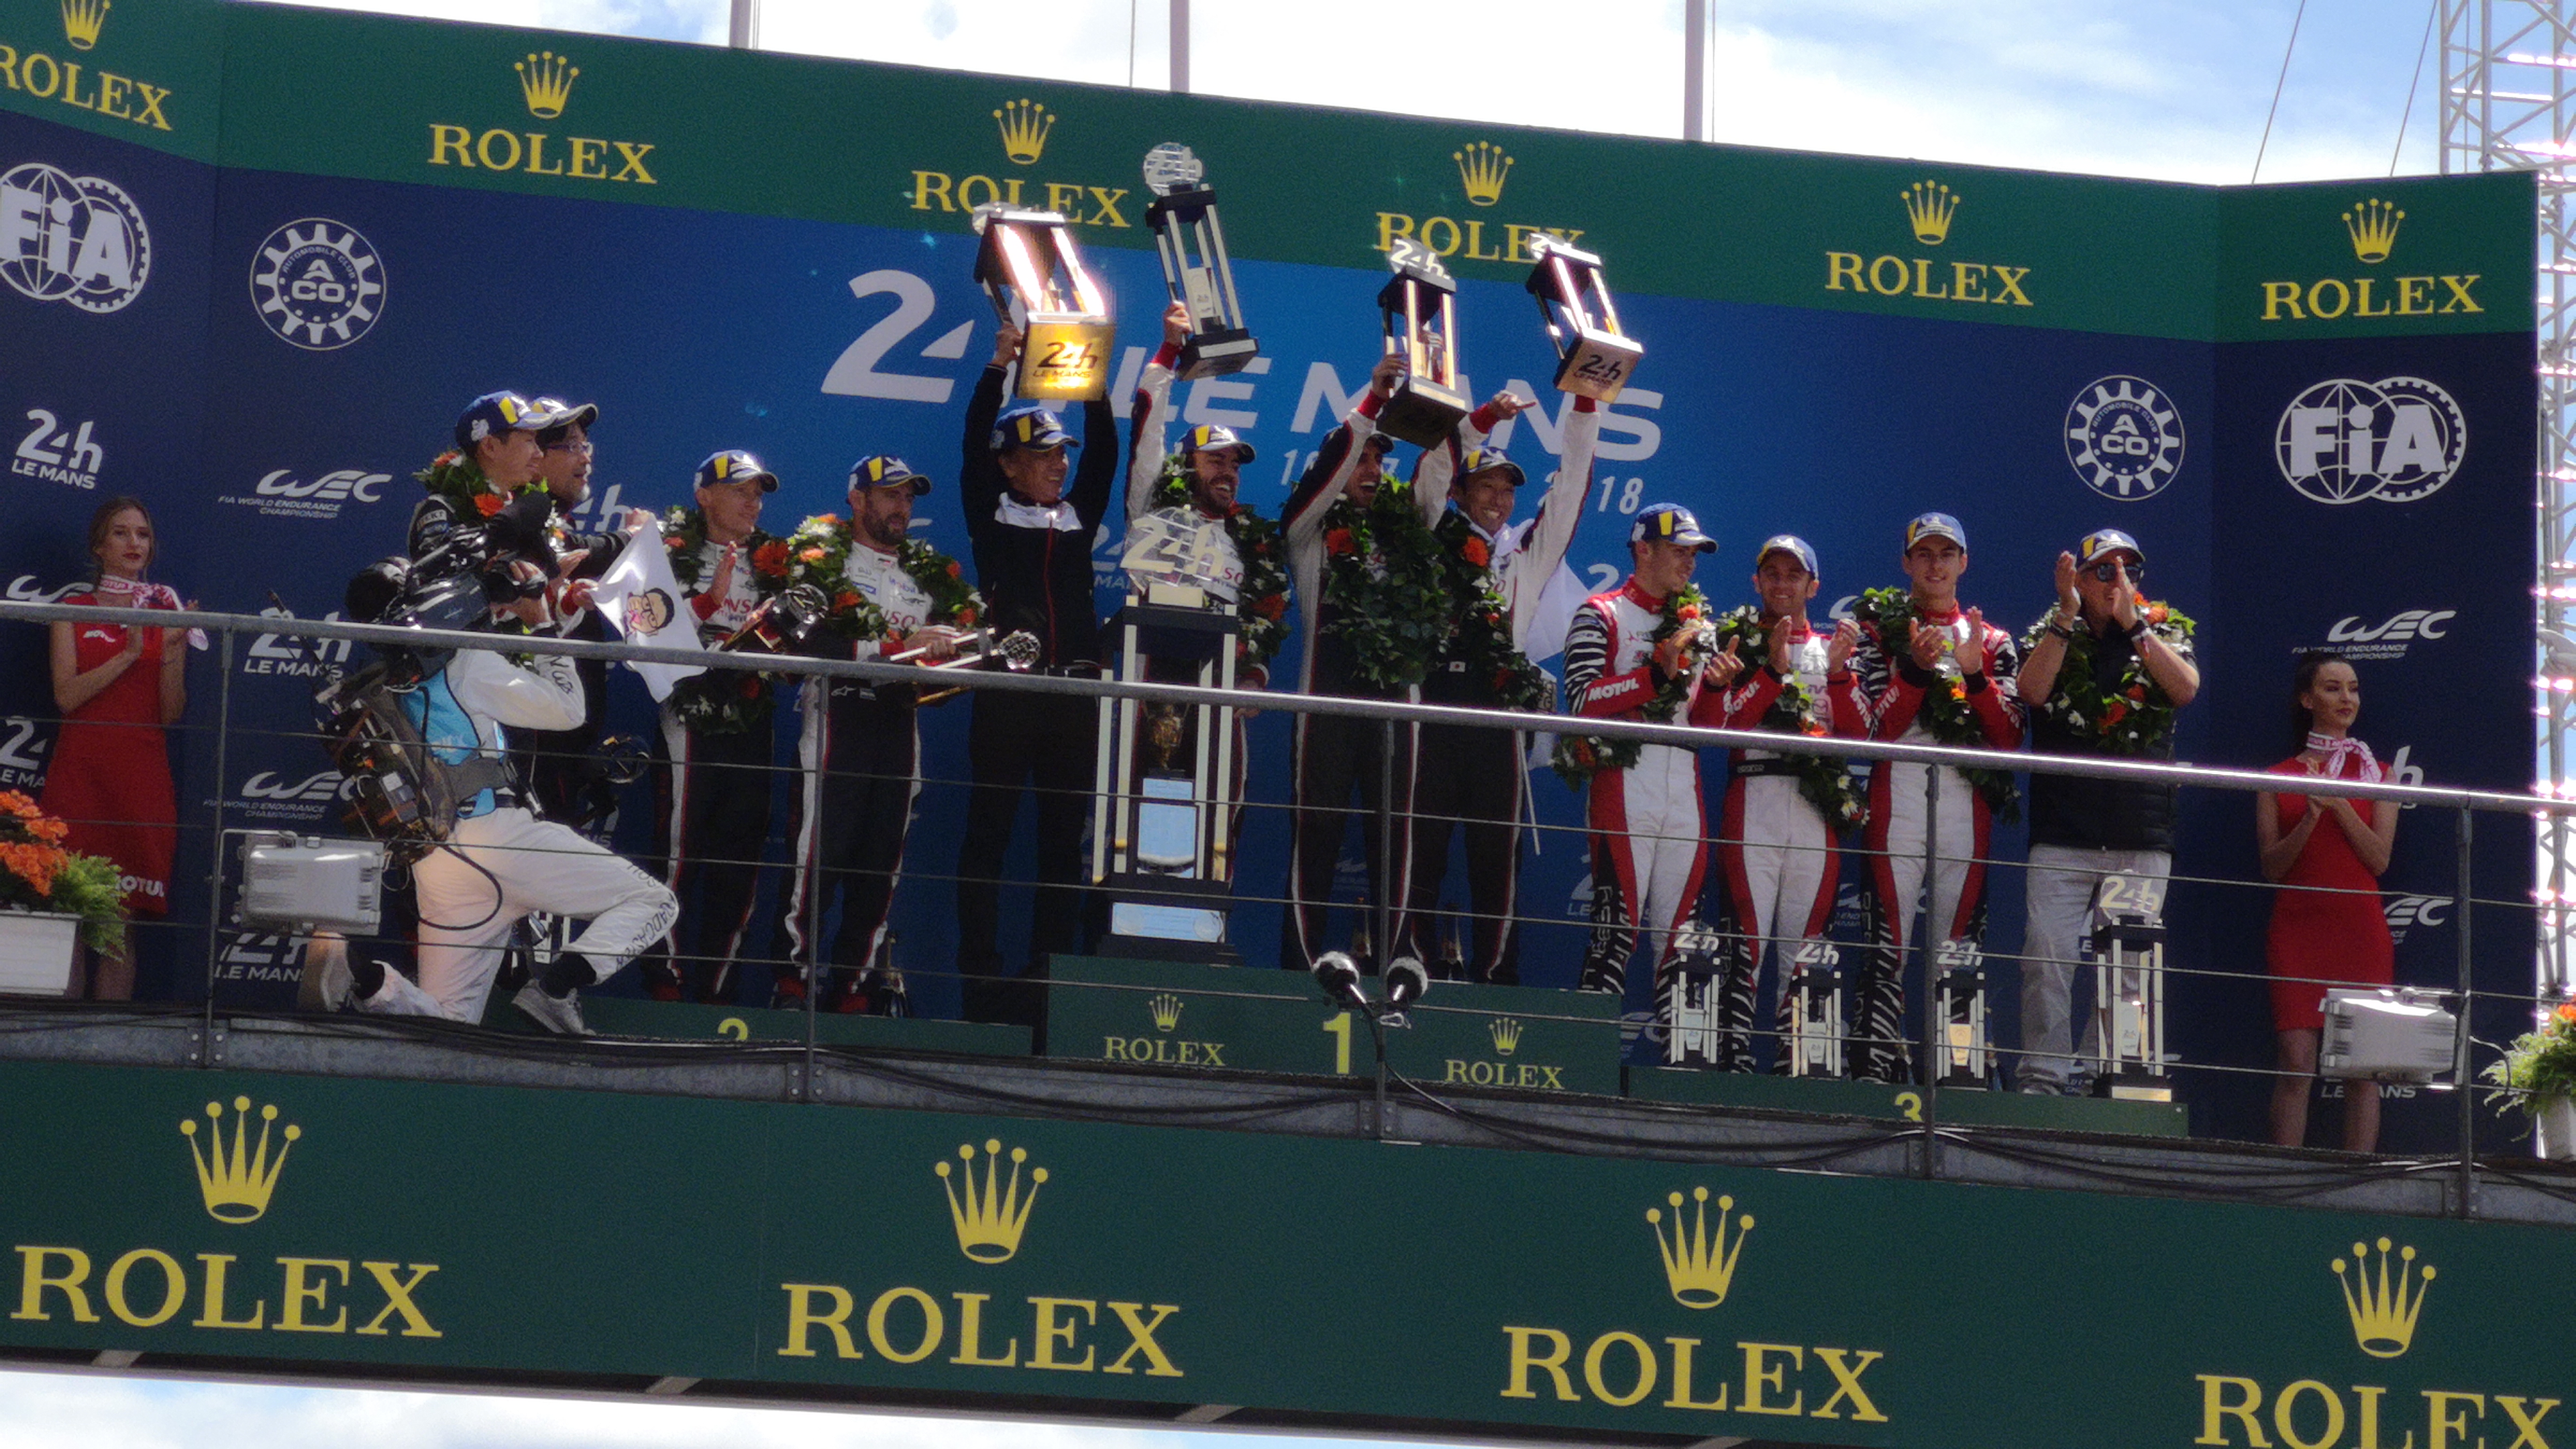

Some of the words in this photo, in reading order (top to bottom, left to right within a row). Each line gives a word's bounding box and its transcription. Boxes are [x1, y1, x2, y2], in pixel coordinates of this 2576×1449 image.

[0, 45, 172, 131] ROLEX
[428, 123, 657, 184] ROLEX
[1825, 252, 2034, 307] ROLEX
[2260, 274, 2485, 320] ROLEX
[1038, 342, 1098, 369] 24h
[1578, 354, 1621, 380] 24h
[1291, 361, 1664, 462] MNS
[16, 409, 103, 474] 24h
[11, 458, 37, 476] LE
[38, 465, 96, 490] MANS
[256, 470, 392, 502] WEC
[217, 496, 235, 504] FIA
[237, 498, 274, 507] WORLD
[274, 500, 342, 512] ENDURANCE
[259, 507, 338, 519] CHAMPIONSHIP
[1120, 515, 1224, 578] 24h
[2326, 610, 2457, 643] WEC
[2345, 644, 2408, 653] ENDURANCE
[244, 659, 274, 674] LE
[1588, 678, 1640, 702] MOTUL
[0, 716, 48, 770] 24
[1, 769, 15, 784] E
[17, 772, 46, 788] MA
[115, 874, 165, 898] OTUL
[2099, 875, 2159, 911] 24h
[2383, 898, 2455, 926] EC
[1674, 925, 1719, 951] 24h
[1104, 1036, 1226, 1066] ROLEX
[1323, 1012, 1351, 1075] 1
[1444, 1059, 1565, 1090] ROLEX
[2321, 1085, 2345, 1098] LE
[11, 1245, 443, 1338] ROLEX
[778, 1283, 1183, 1378] ROLEX
[1500, 1326, 1888, 1422] ROLEX
[2194, 1374, 2561, 1449] ROLEX
